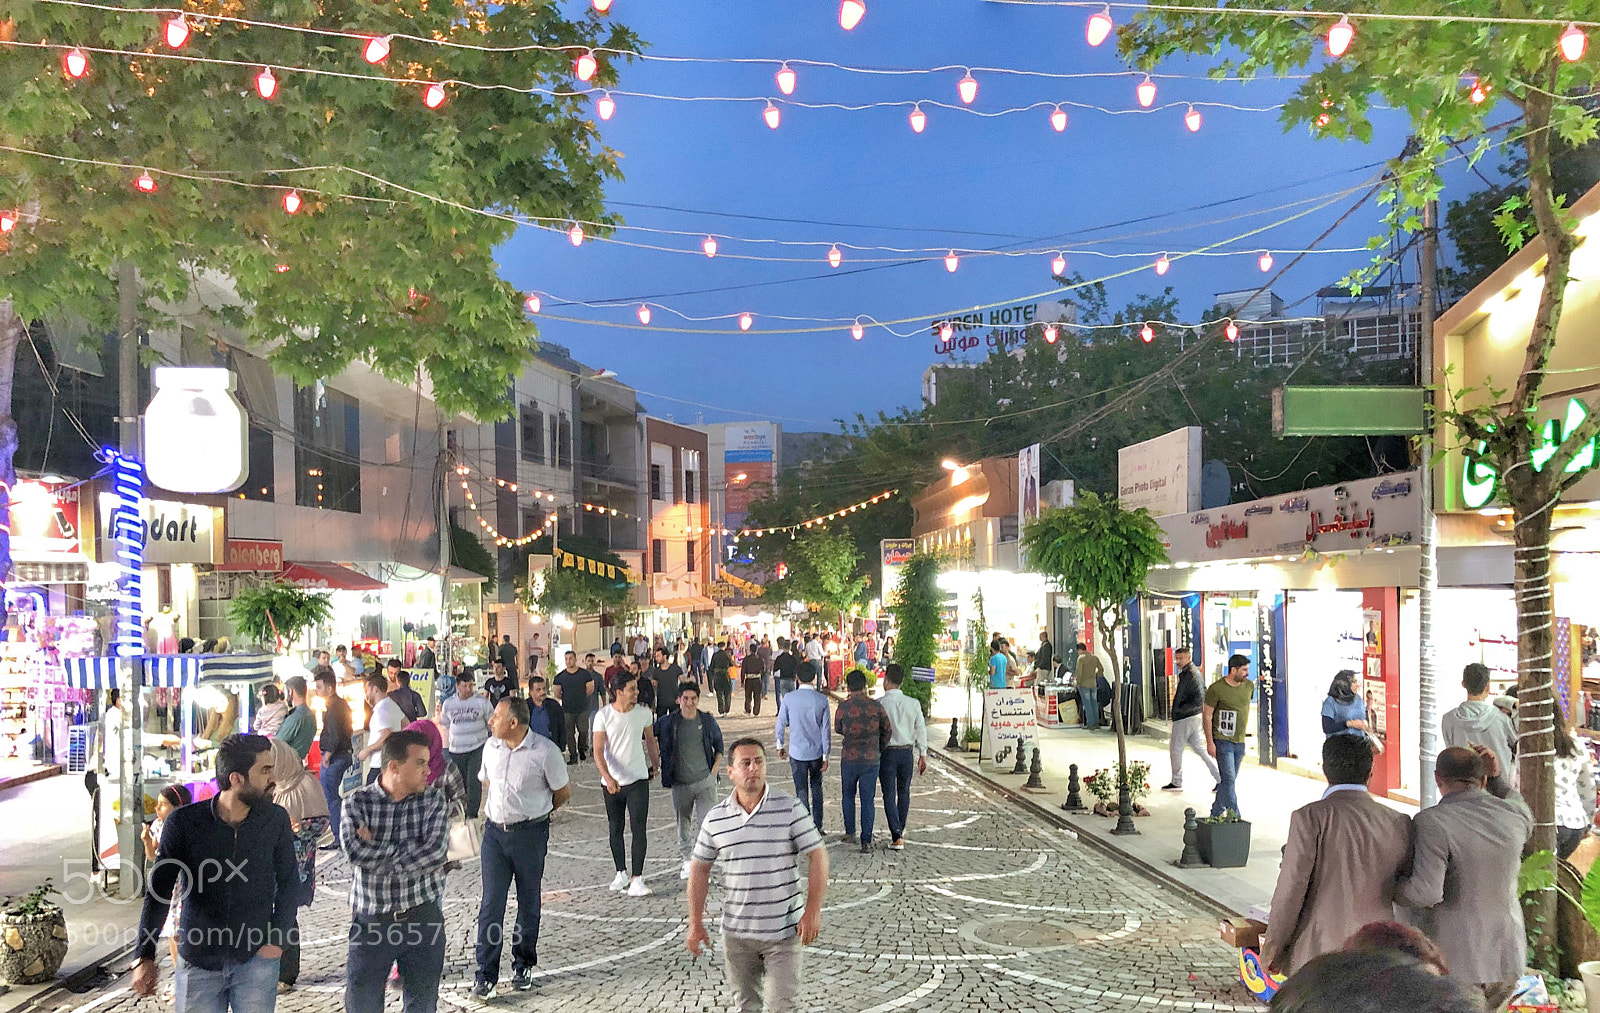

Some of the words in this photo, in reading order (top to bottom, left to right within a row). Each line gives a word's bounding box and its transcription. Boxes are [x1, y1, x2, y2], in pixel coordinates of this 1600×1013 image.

[1135, 481, 1149, 493] Photo
[1150, 476, 1167, 491] Digital
[1221, 711, 1234, 720] UP
[1221, 721, 1233, 730] ON
